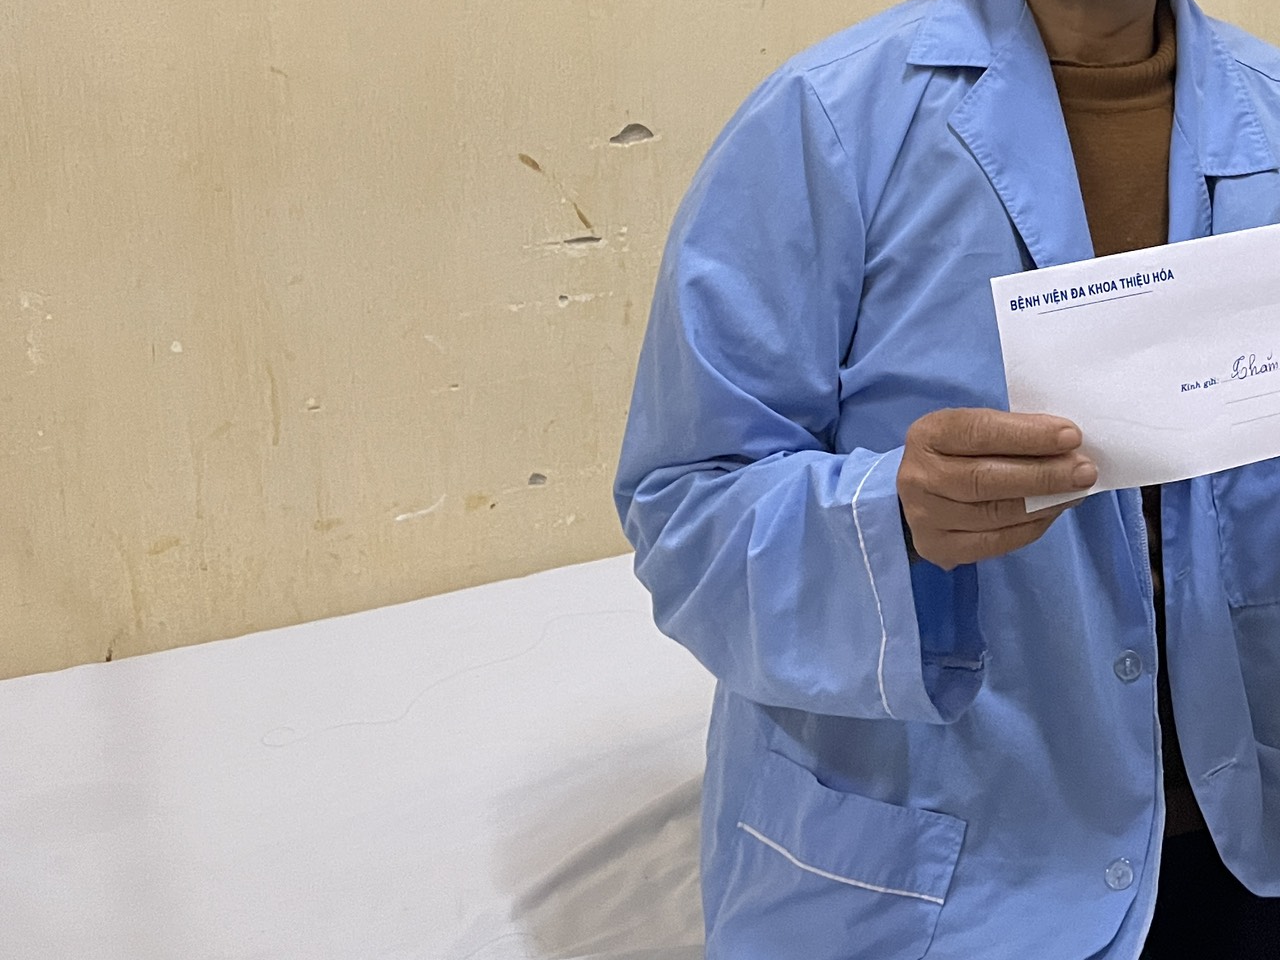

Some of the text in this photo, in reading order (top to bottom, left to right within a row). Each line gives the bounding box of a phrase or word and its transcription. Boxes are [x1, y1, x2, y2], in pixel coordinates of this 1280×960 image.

[1010, 268, 1174, 312] BỆNH VIỆN ĐA KHOA THIỆU HÓA
